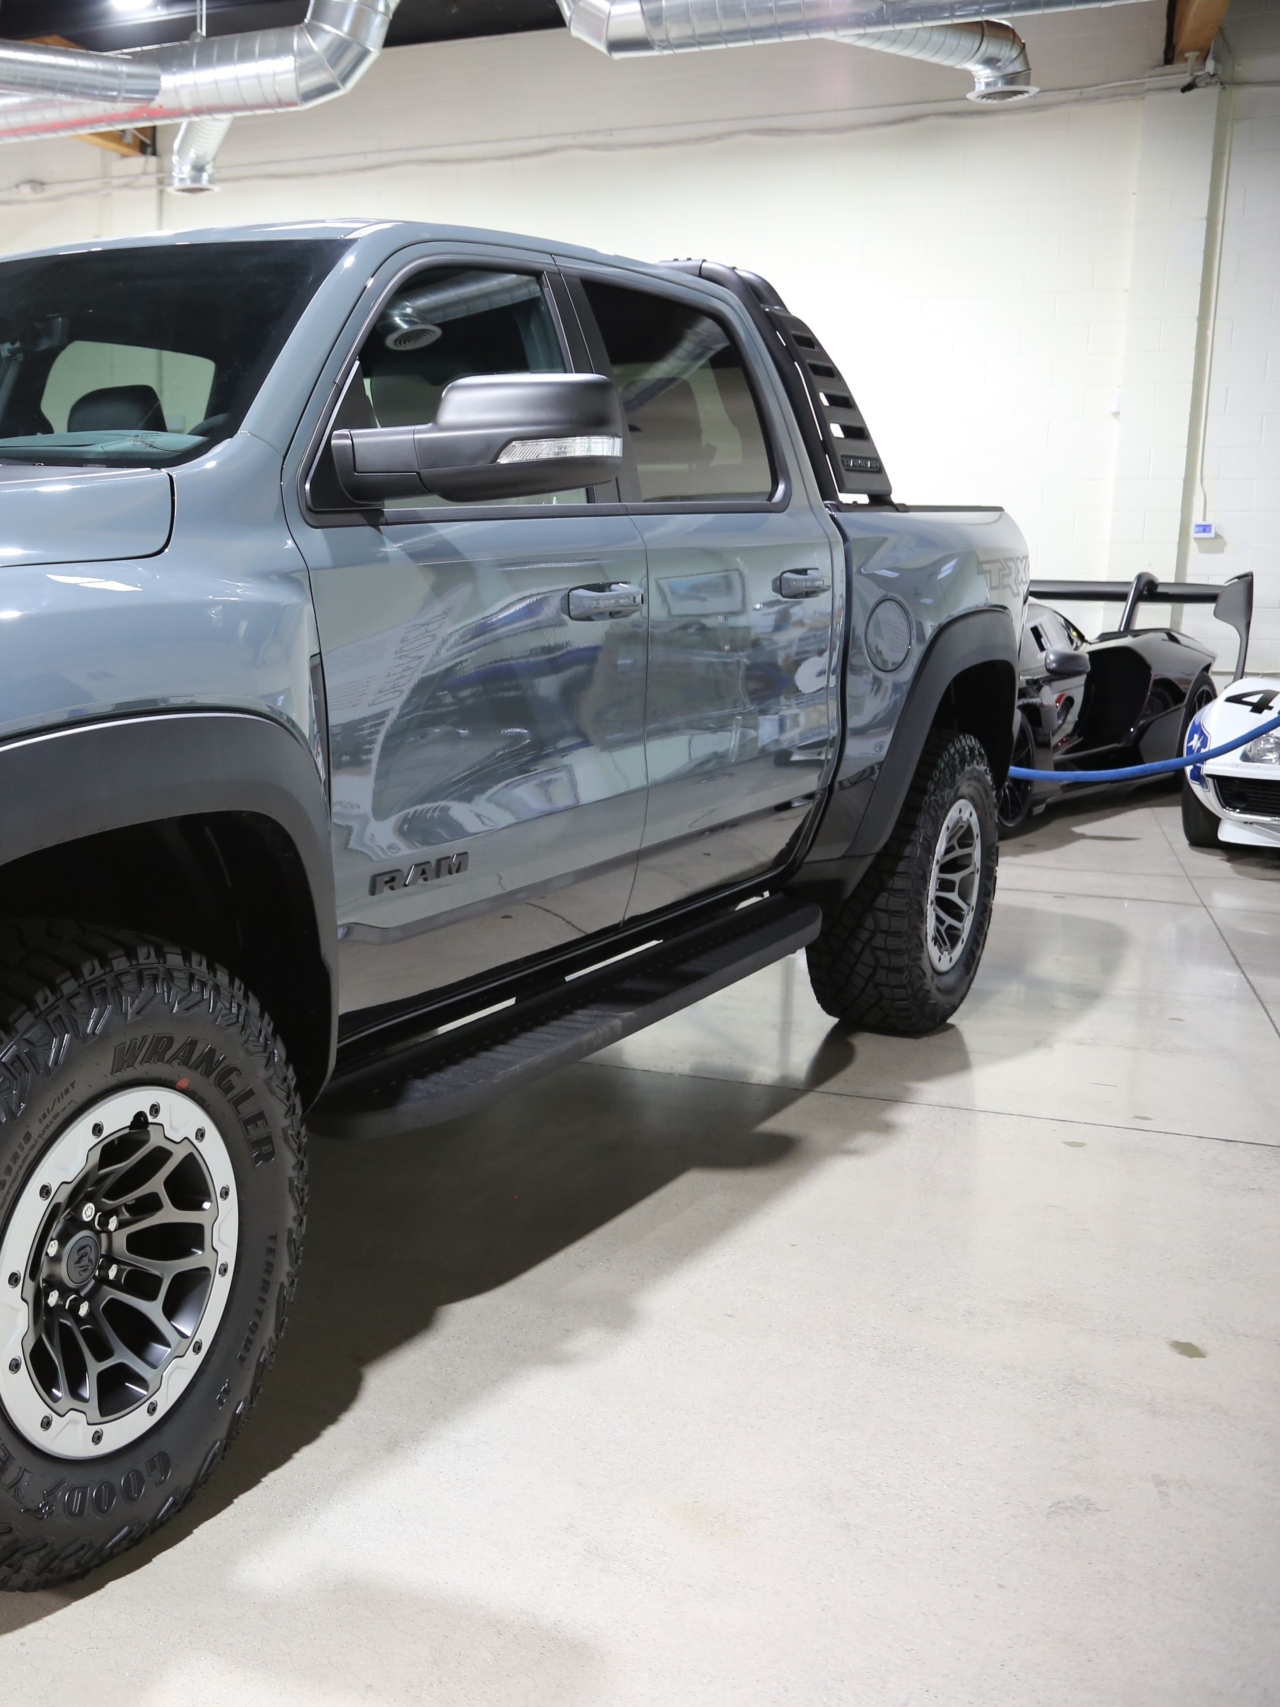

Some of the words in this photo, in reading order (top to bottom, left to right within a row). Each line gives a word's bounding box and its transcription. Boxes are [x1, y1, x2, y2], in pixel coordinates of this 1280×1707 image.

[977, 555, 1030, 598] TRX
[368, 851, 469, 896] RAM
[111, 1033, 276, 1168] WRANGLER
